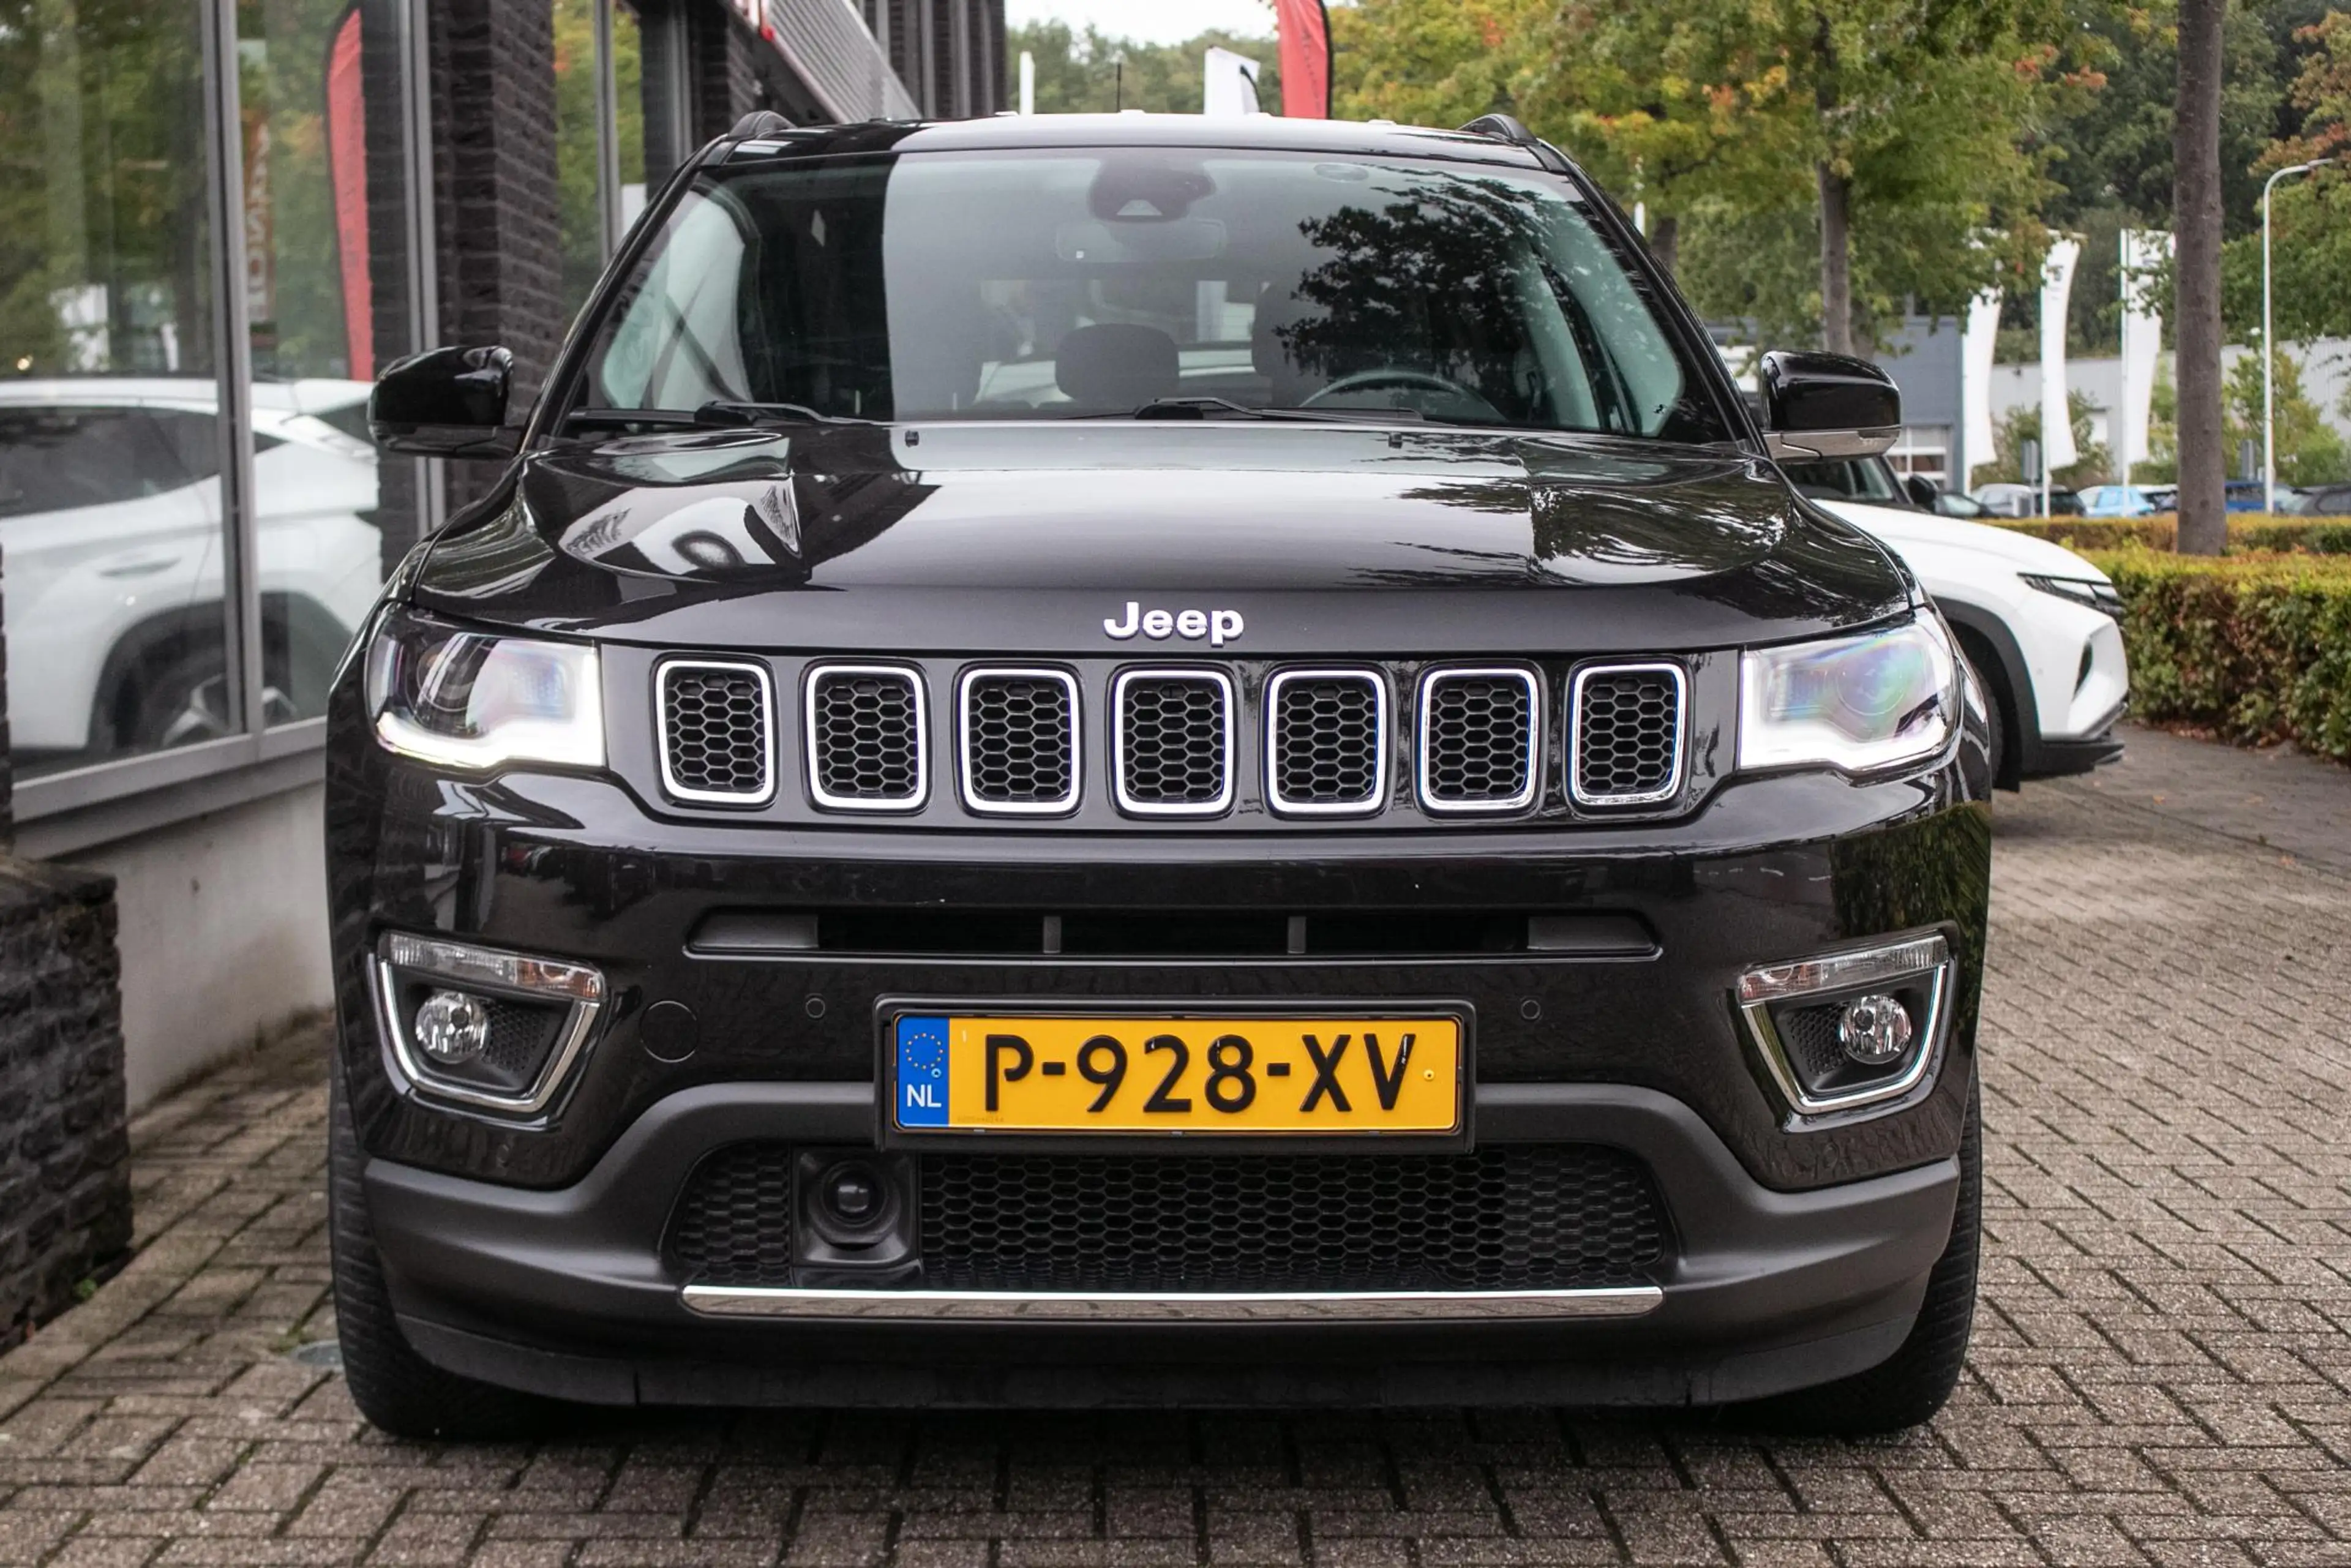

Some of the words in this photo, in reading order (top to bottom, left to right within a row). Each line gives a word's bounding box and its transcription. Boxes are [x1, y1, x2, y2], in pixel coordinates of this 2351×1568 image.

[1103, 601, 1245, 647] Jeep
[907, 1084, 942, 1108] NL
[985, 1033, 1416, 1114] P-928-XV
